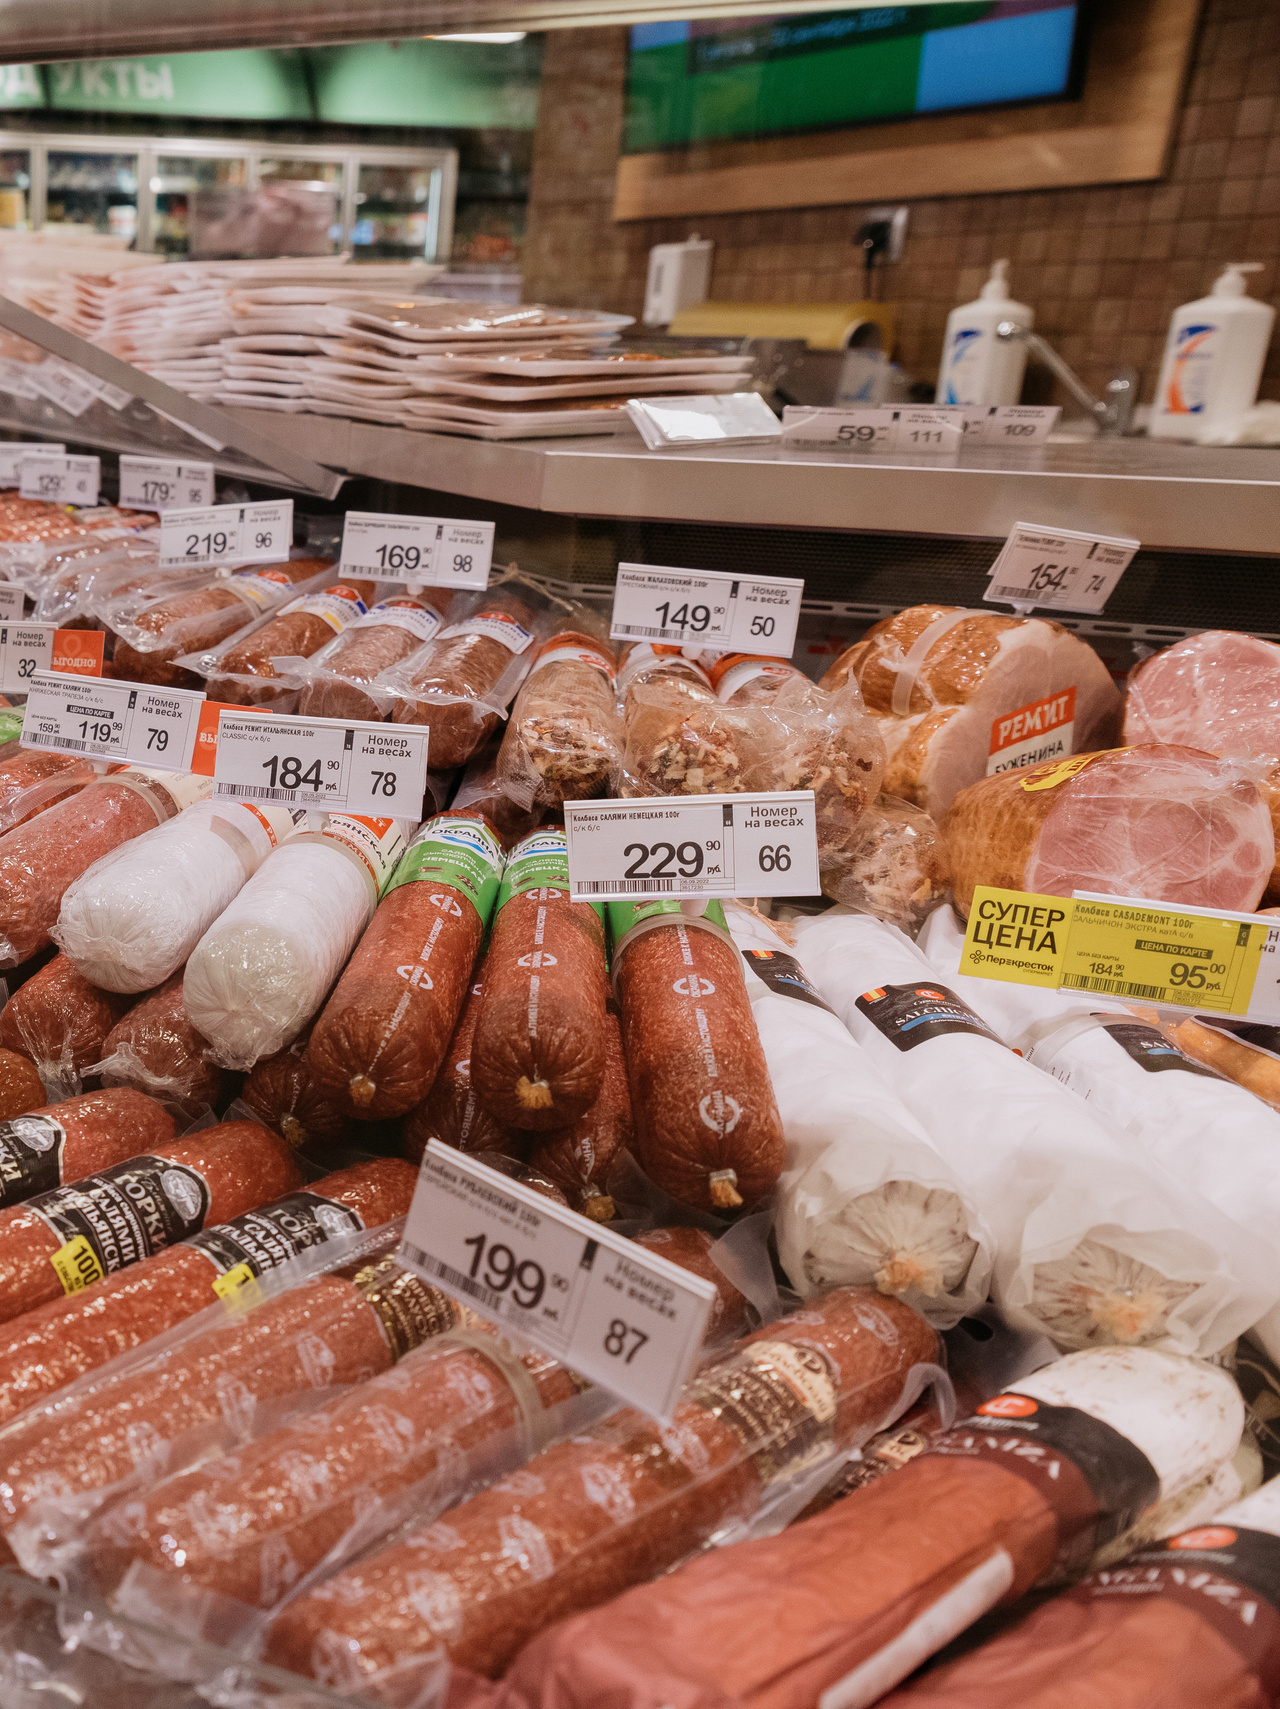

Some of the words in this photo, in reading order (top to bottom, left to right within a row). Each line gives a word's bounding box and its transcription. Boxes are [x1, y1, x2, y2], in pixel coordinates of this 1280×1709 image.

[836, 425, 876, 442] 59
[910, 431, 943, 443] 111
[1003, 424, 1037, 437] 109
[141, 481, 170, 501] 179
[186, 532, 228, 556] 219
[254, 532, 273, 549] 96
[376, 544, 422, 570] 169
[452, 554, 473, 573] 98
[1028, 562, 1069, 592] 154
[1084, 575, 1106, 594] 74
[752, 586, 788, 598] Номер
[760, 596, 791, 605] весах
[655, 601, 711, 632] 149
[714, 606, 725, 615] 90
[17, 631, 43, 641] Номер
[750, 616, 776, 637] 50
[24, 640, 46, 648] весах
[18, 658, 37, 678] 32
[70, 706, 84, 714] ЦЕНА
[94, 709, 111, 718] КАРТЕ
[147, 695, 180, 710] Номер
[142, 706, 154, 714] на
[155, 708, 183, 719] весах
[998, 695, 1070, 746] РЕМИТ
[39, 722, 54, 733] 159
[78, 720, 112, 742] 119
[112, 721, 123, 731] 99
[223, 723, 243, 731] Колбаса
[263, 727, 301, 736] ИТАЛЬЯНСКАЯ
[302, 730, 315, 738] 100г
[146, 728, 169, 751] 79
[222, 732, 248, 741] CLASSIC
[248, 734, 259, 742] с/к
[260, 735, 271, 743] б/с
[368, 734, 408, 749] Номер
[361, 745, 376, 755] на
[378, 748, 412, 758] весах
[262, 755, 324, 792] 184
[327, 760, 340, 771] 90
[371, 770, 397, 797] 78
[573, 814, 599, 822] Колбаса
[600, 813, 627, 821] САЛЯМИ
[628, 812, 664, 820] НЕМЕЦКАЯ
[665, 811, 680, 819] 100г
[750, 806, 798, 819] Номер
[573, 824, 586, 832] с/к
[587, 823, 600, 832] б/с
[744, 818, 765, 828] на
[766, 817, 804, 828] весах
[331, 819, 387, 869] ЬЯНСКАЯ
[432, 829, 495, 860] ОКРАИНА
[513, 842, 567, 859] ОКРАИН
[623, 841, 704, 879] 229
[705, 840, 721, 851] 90
[758, 844, 792, 872] 66
[422, 856, 484, 884] НЕМЕЦКАЯ
[510, 867, 568, 882] НЕМЕЦКА
[707, 865, 721, 875] руб.
[978, 899, 1066, 929] СУПЕР
[1075, 904, 1110, 917] Колбаса
[1113, 910, 1171, 926] CASADEMONT
[1173, 918, 1194, 929] 100г
[1073, 915, 1123, 929] САЛЬЧИЧОН
[1125, 922, 1158, 934] ЭКСТРА
[972, 921, 1058, 955] ЦЕНА
[1141, 941, 1165, 950] ЦЕНА
[1165, 945, 1179, 953] ПО
[1180, 947, 1208, 958] КАРТЕ
[1259, 944, 1276, 953] на
[985, 954, 1054, 973] Перекресток
[1089, 962, 1113, 977] 184
[1169, 962, 1209, 989] 95
[1210, 963, 1226, 975] 00
[1205, 982, 1221, 991] руб.
[113, 1174, 169, 1250] ГОРКИ
[57, 1187, 121, 1275] ИТАЛЬЯНСК
[90, 1188, 136, 1263] САЛЯМИ
[72, 1245, 101, 1286] 100
[464, 1233, 546, 1310] 199
[616, 1256, 676, 1302] Номер
[604, 1319, 649, 1365] 87
